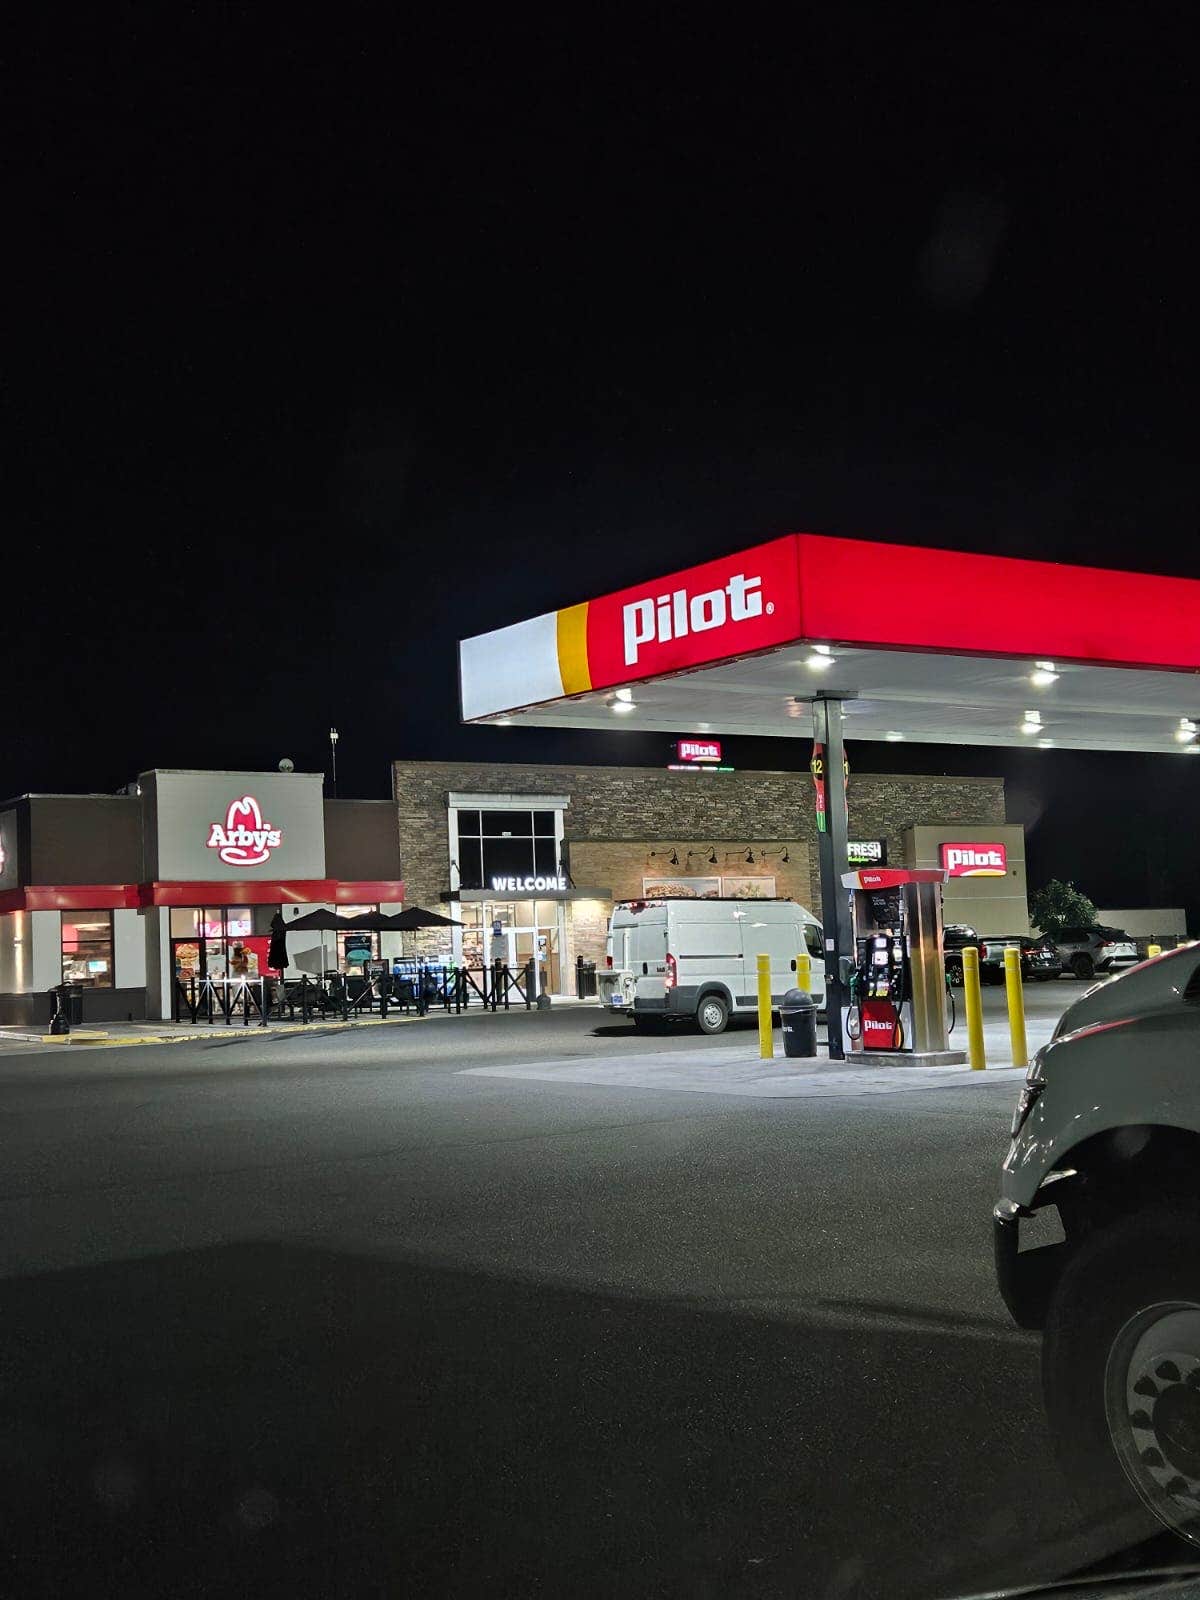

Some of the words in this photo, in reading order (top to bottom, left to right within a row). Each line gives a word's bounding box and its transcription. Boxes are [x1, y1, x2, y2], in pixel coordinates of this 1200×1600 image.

[622, 573, 763, 666] Pilot
[680, 743, 719, 758] Pilot
[811, 760, 823, 774] 12
[208, 823, 282, 853] Arby's
[847, 842, 882, 858] FRESH
[947, 849, 1004, 870] Pilot
[492, 877, 567, 891] WELCOME
[864, 1020, 893, 1031] Pilot
